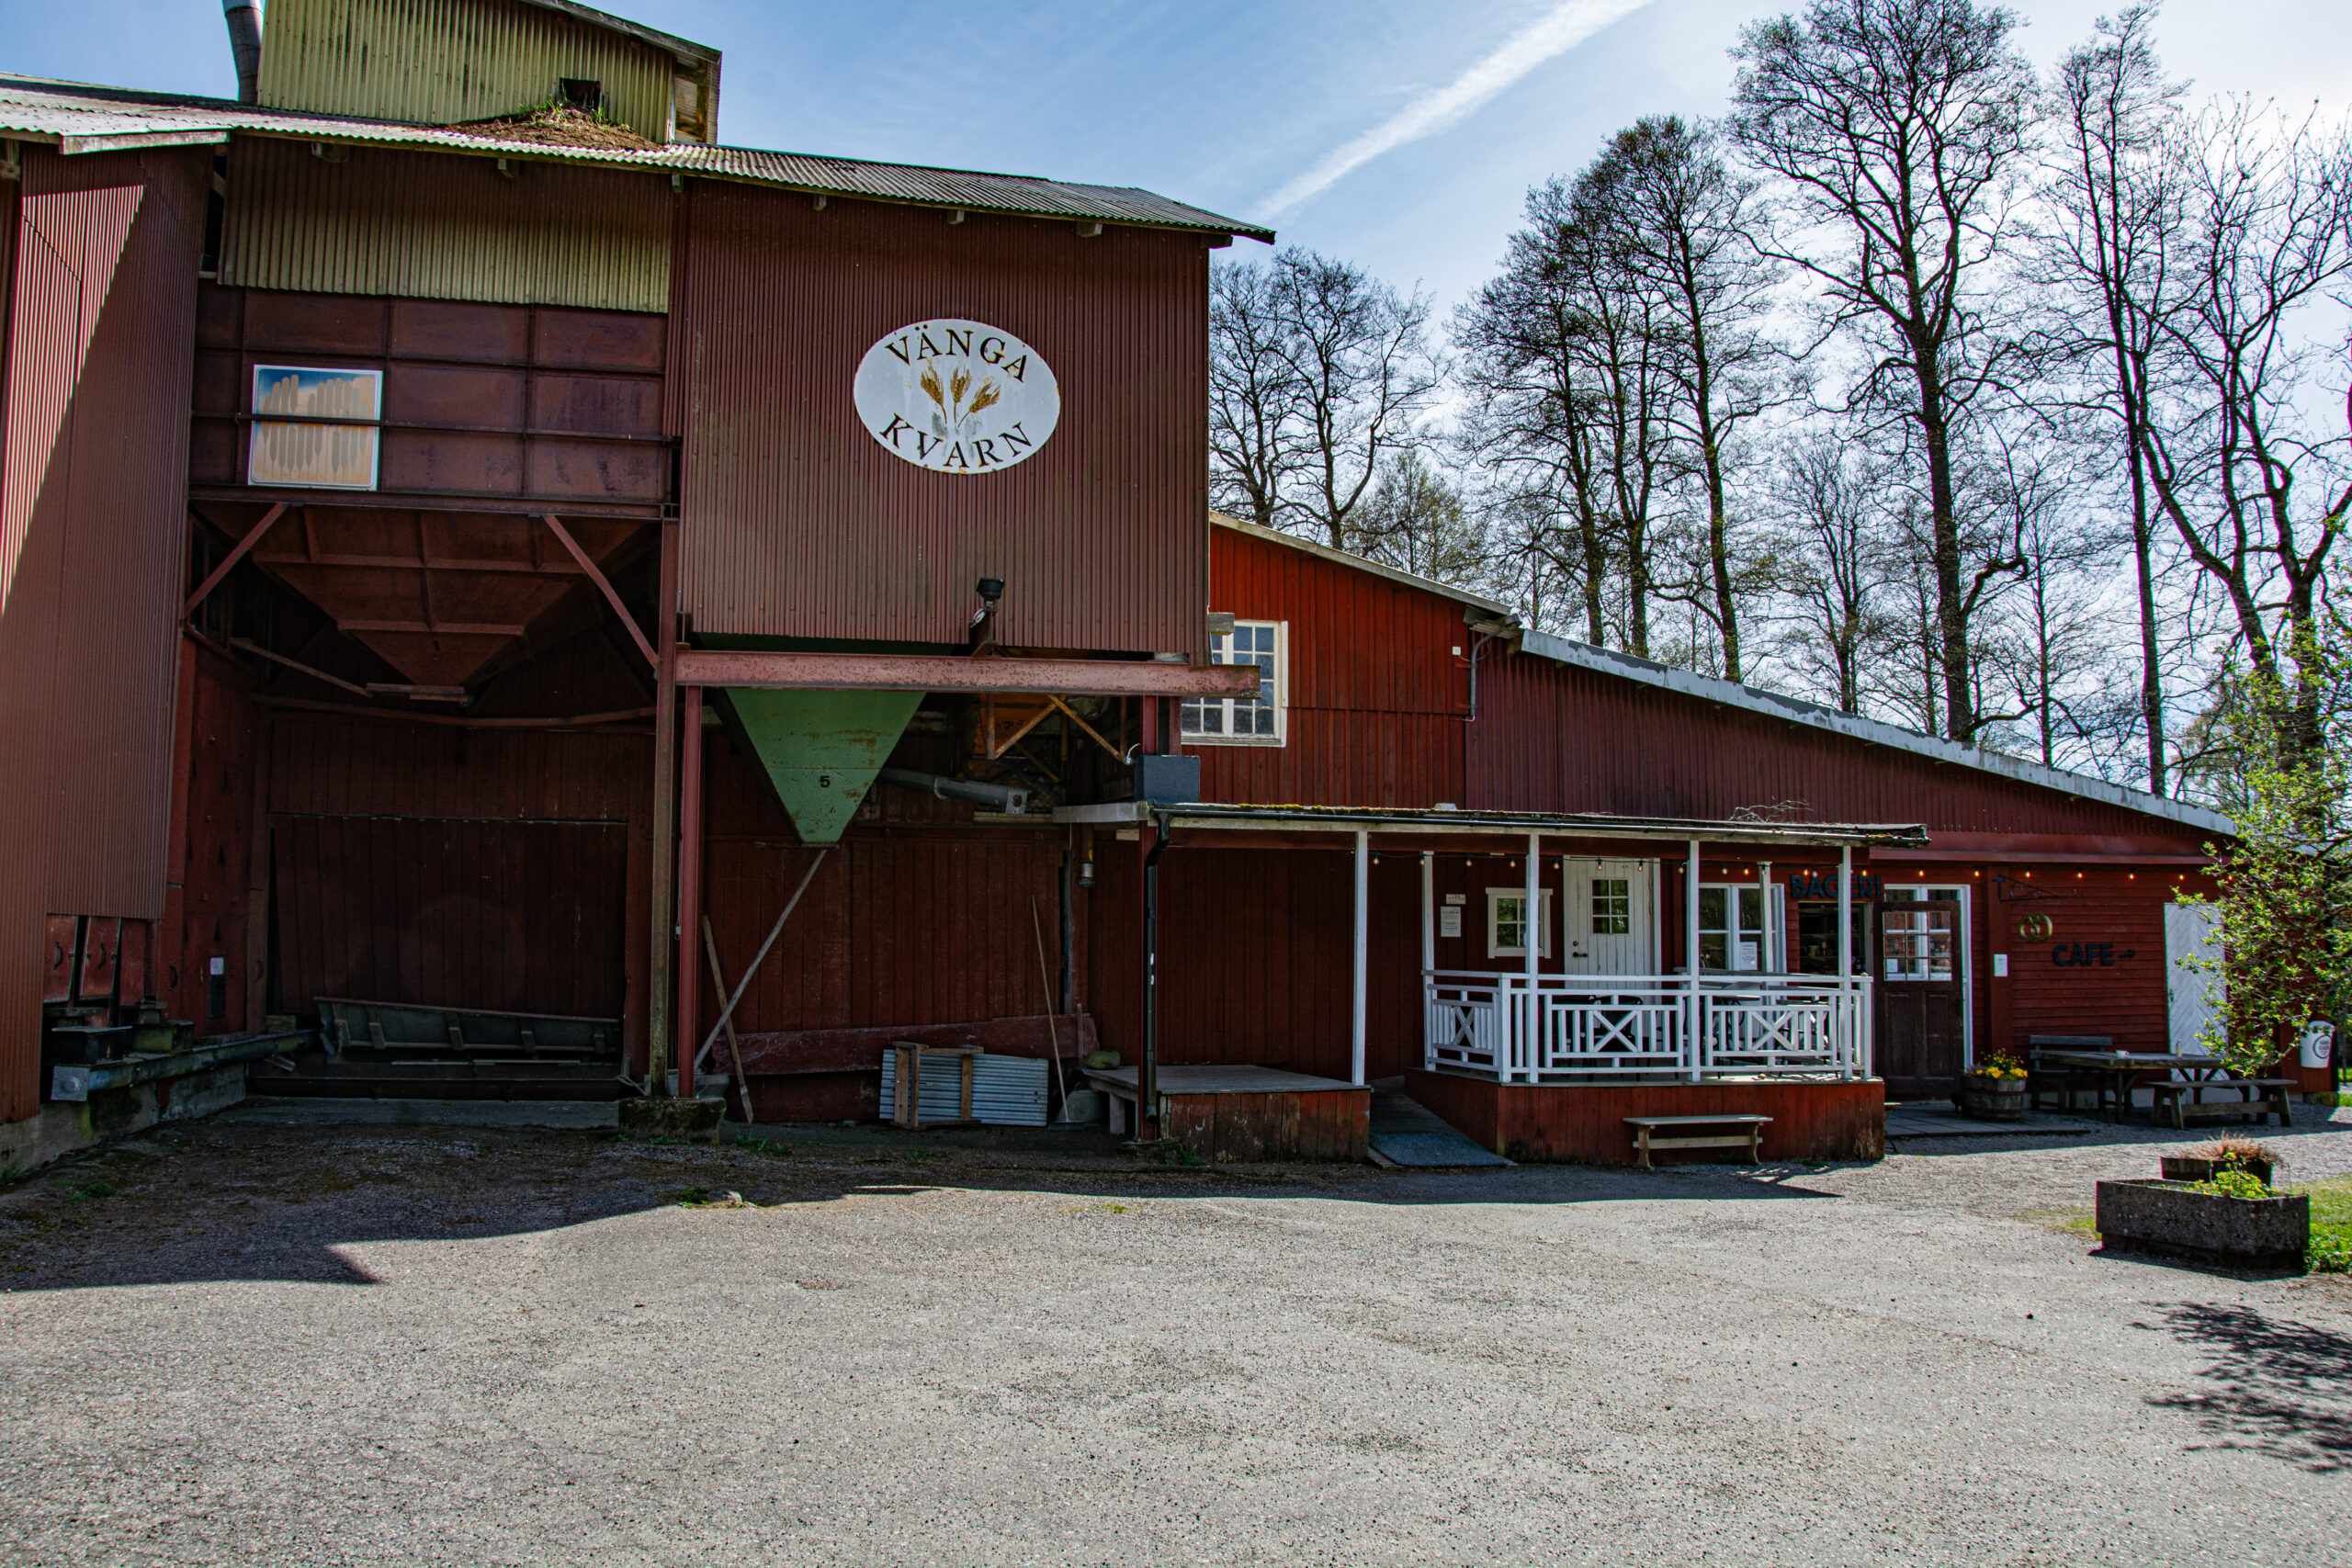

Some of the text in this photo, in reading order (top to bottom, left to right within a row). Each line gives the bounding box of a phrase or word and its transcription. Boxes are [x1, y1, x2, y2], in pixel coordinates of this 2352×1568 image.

[885, 324, 1027, 382] VÄNGA
[879, 412, 1032, 468] KVARN
[820, 775, 831, 788] 5
[1791, 874, 1882, 898] BAGERI
[2053, 942, 2115, 966] CAFE
